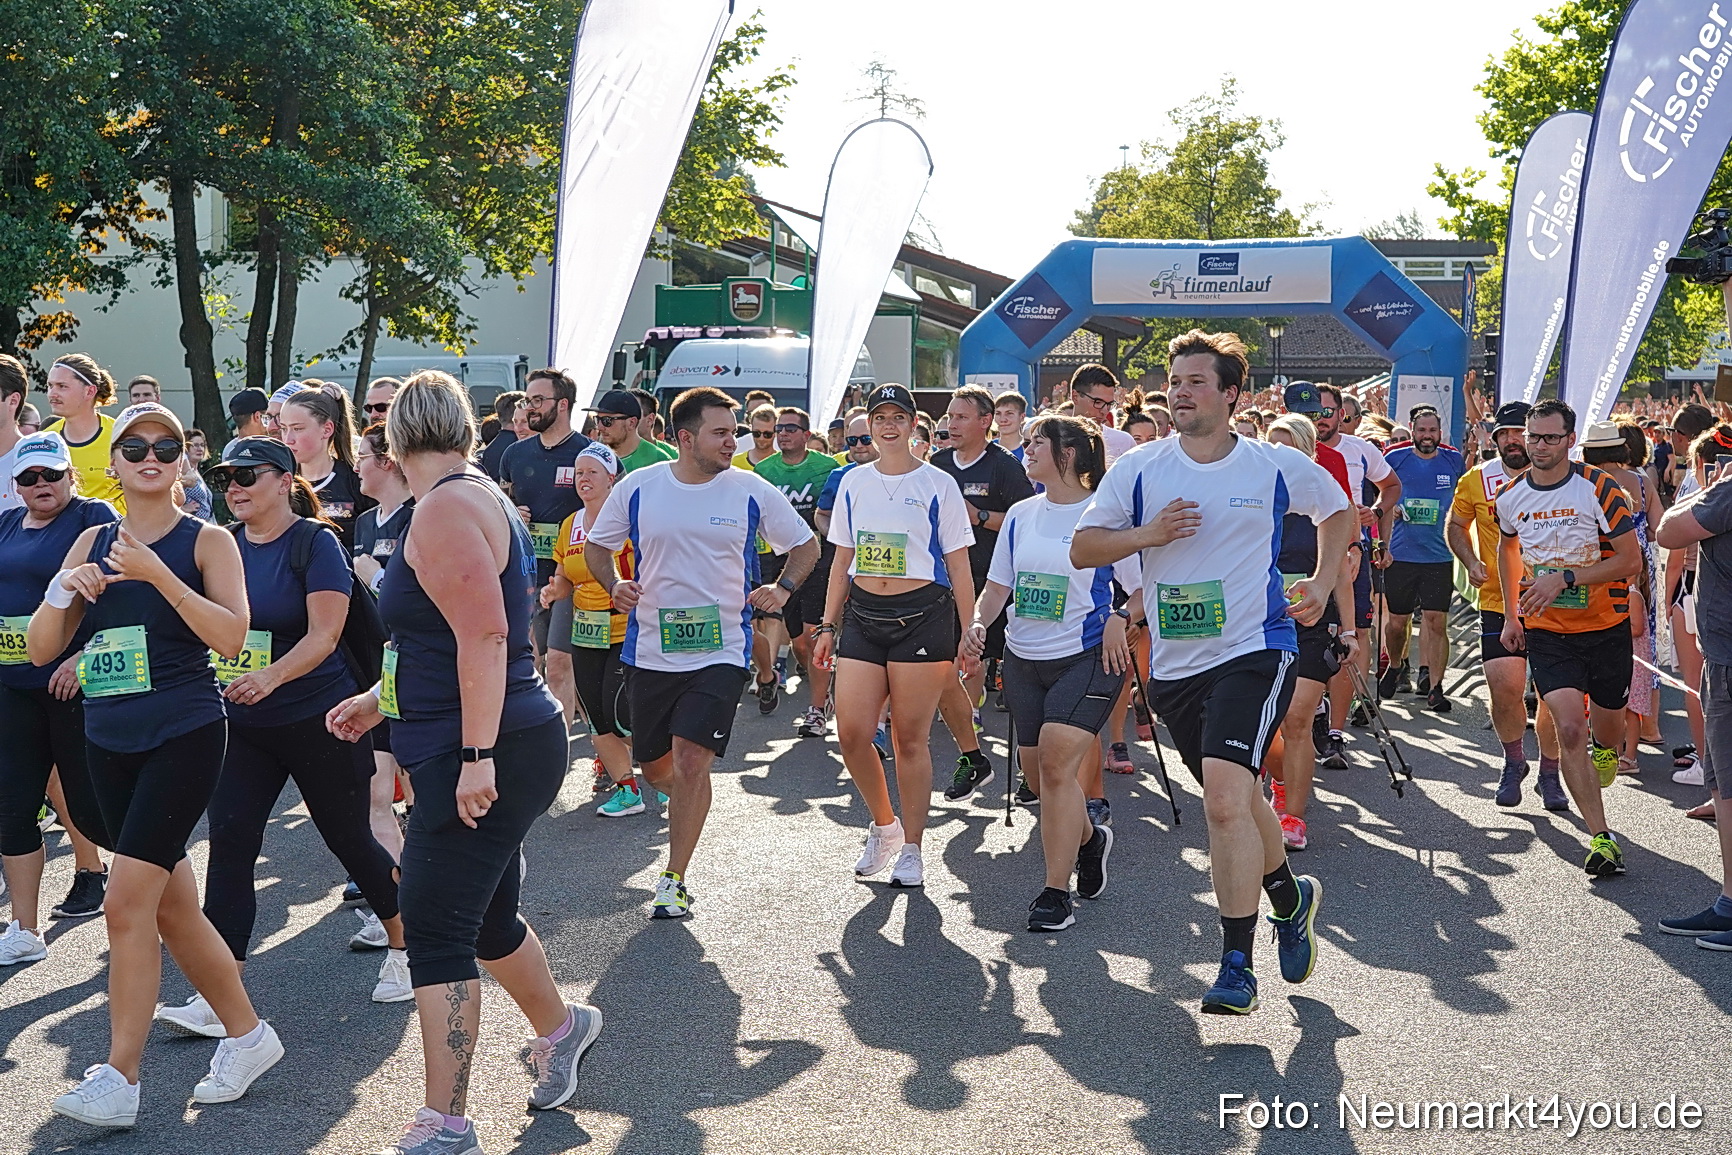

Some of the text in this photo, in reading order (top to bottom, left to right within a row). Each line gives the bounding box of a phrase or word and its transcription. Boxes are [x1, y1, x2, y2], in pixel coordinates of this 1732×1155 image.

[1643, 2, 1728, 154] Fischer
[1680, 27, 1732, 148] AUTOMOBIL
[1541, 138, 1587, 241] Fischer
[1184, 275, 1273, 293] firmenlauf
[1013, 304, 1061, 315] Fischer
[1359, 305, 1373, 313] und
[1373, 302, 1387, 310] das
[669, 365, 710, 375] abavent
[1412, 507, 1430, 517] 140
[1532, 508, 1579, 521] KLEBL
[1533, 517, 1579, 531] DYNAMICS
[865, 547, 892, 562] 324
[881, 561, 895, 569] Erika
[1022, 587, 1051, 605] 309
[1055, 594, 1064, 616] 2022
[1169, 602, 1206, 622] 320
[1213, 603, 1224, 629] 2022
[575, 622, 603, 636] 1007
[663, 622, 720, 645] RUN 307 2022
[0, 633, 27, 650] 483
[91, 650, 126, 675] 493
[134, 652, 146, 683] 2022
[109, 674, 137, 682] Rebecca
[1225, 739, 1250, 750] adidas
